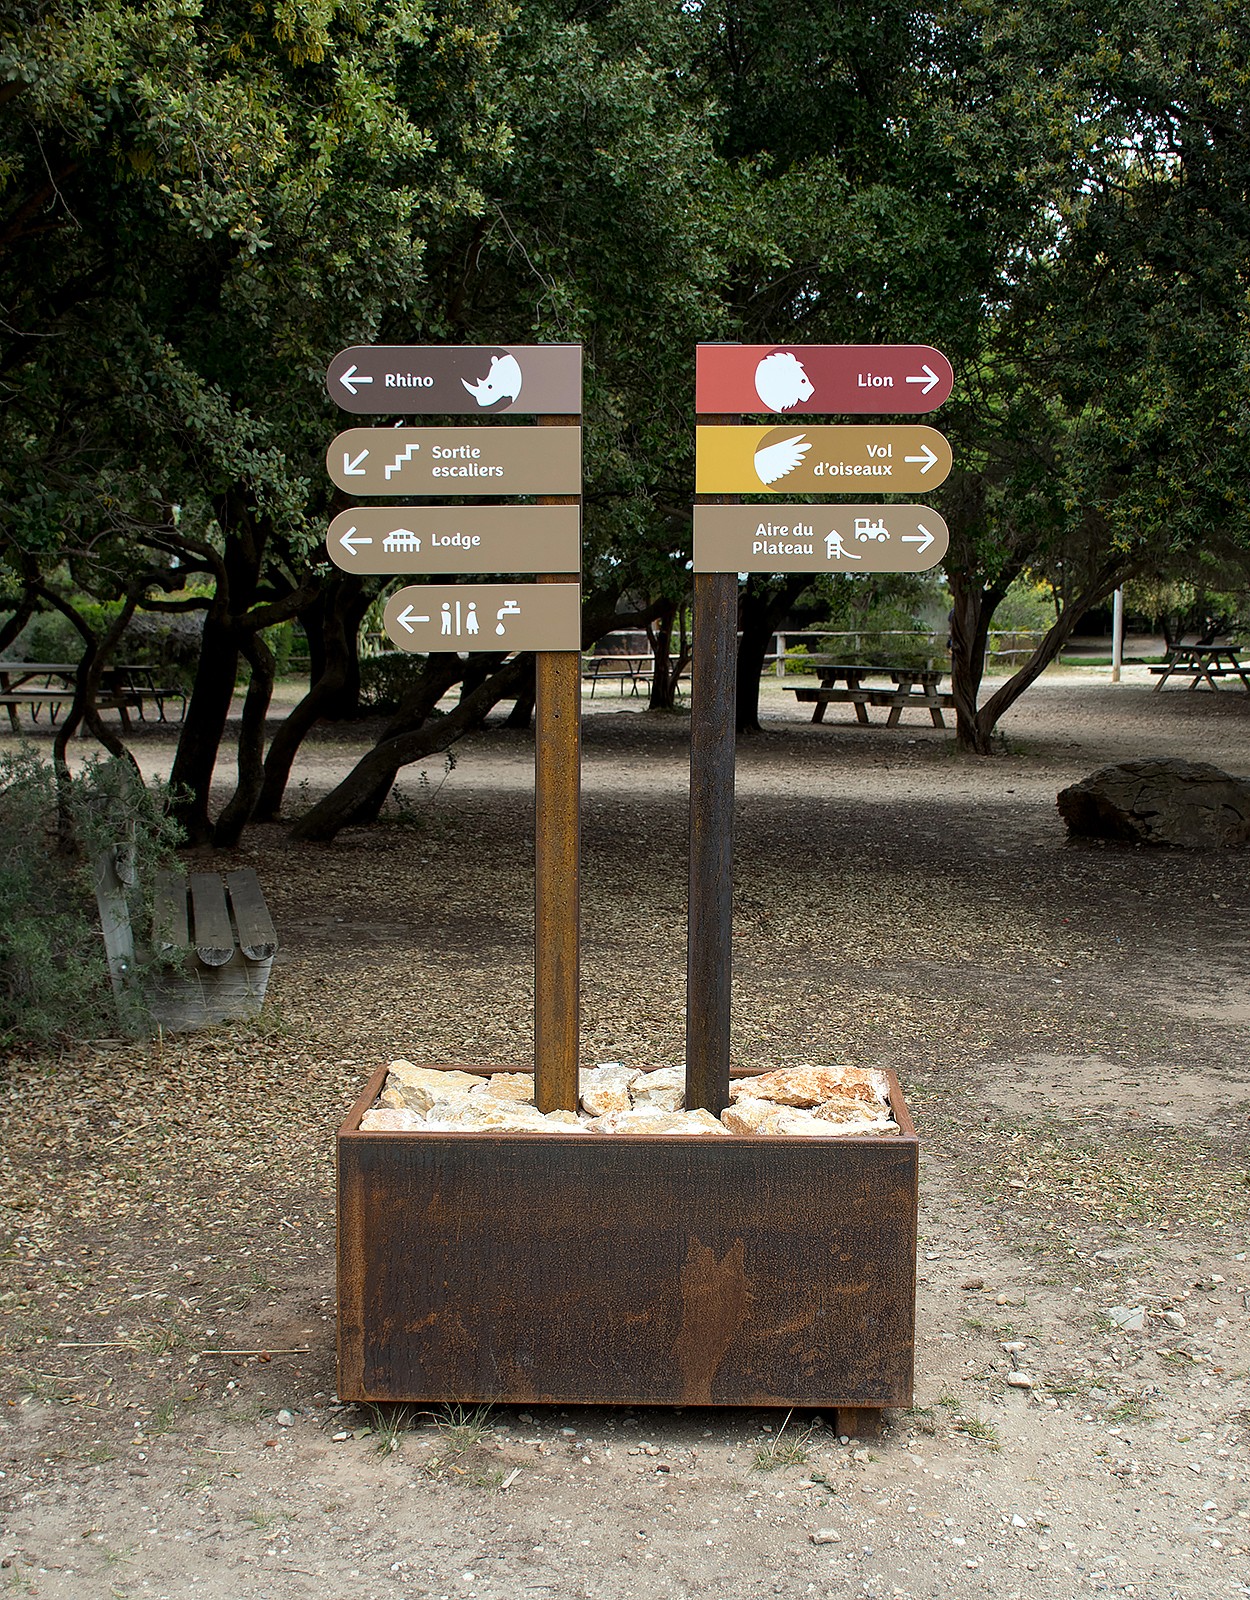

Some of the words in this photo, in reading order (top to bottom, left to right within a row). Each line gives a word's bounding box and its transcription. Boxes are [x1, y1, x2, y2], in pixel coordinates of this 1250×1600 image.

[385, 372, 434, 388] Rhino
[858, 372, 894, 387] Lion
[432, 444, 481, 459] Sortie
[866, 443, 893, 458] Vol
[431, 462, 504, 478] escaliers
[813, 461, 893, 476] d’oiseaux
[755, 522, 789, 537] Aire
[792, 522, 814, 537] du
[431, 532, 481, 550] Lodge
[752, 540, 814, 555] Plateau
